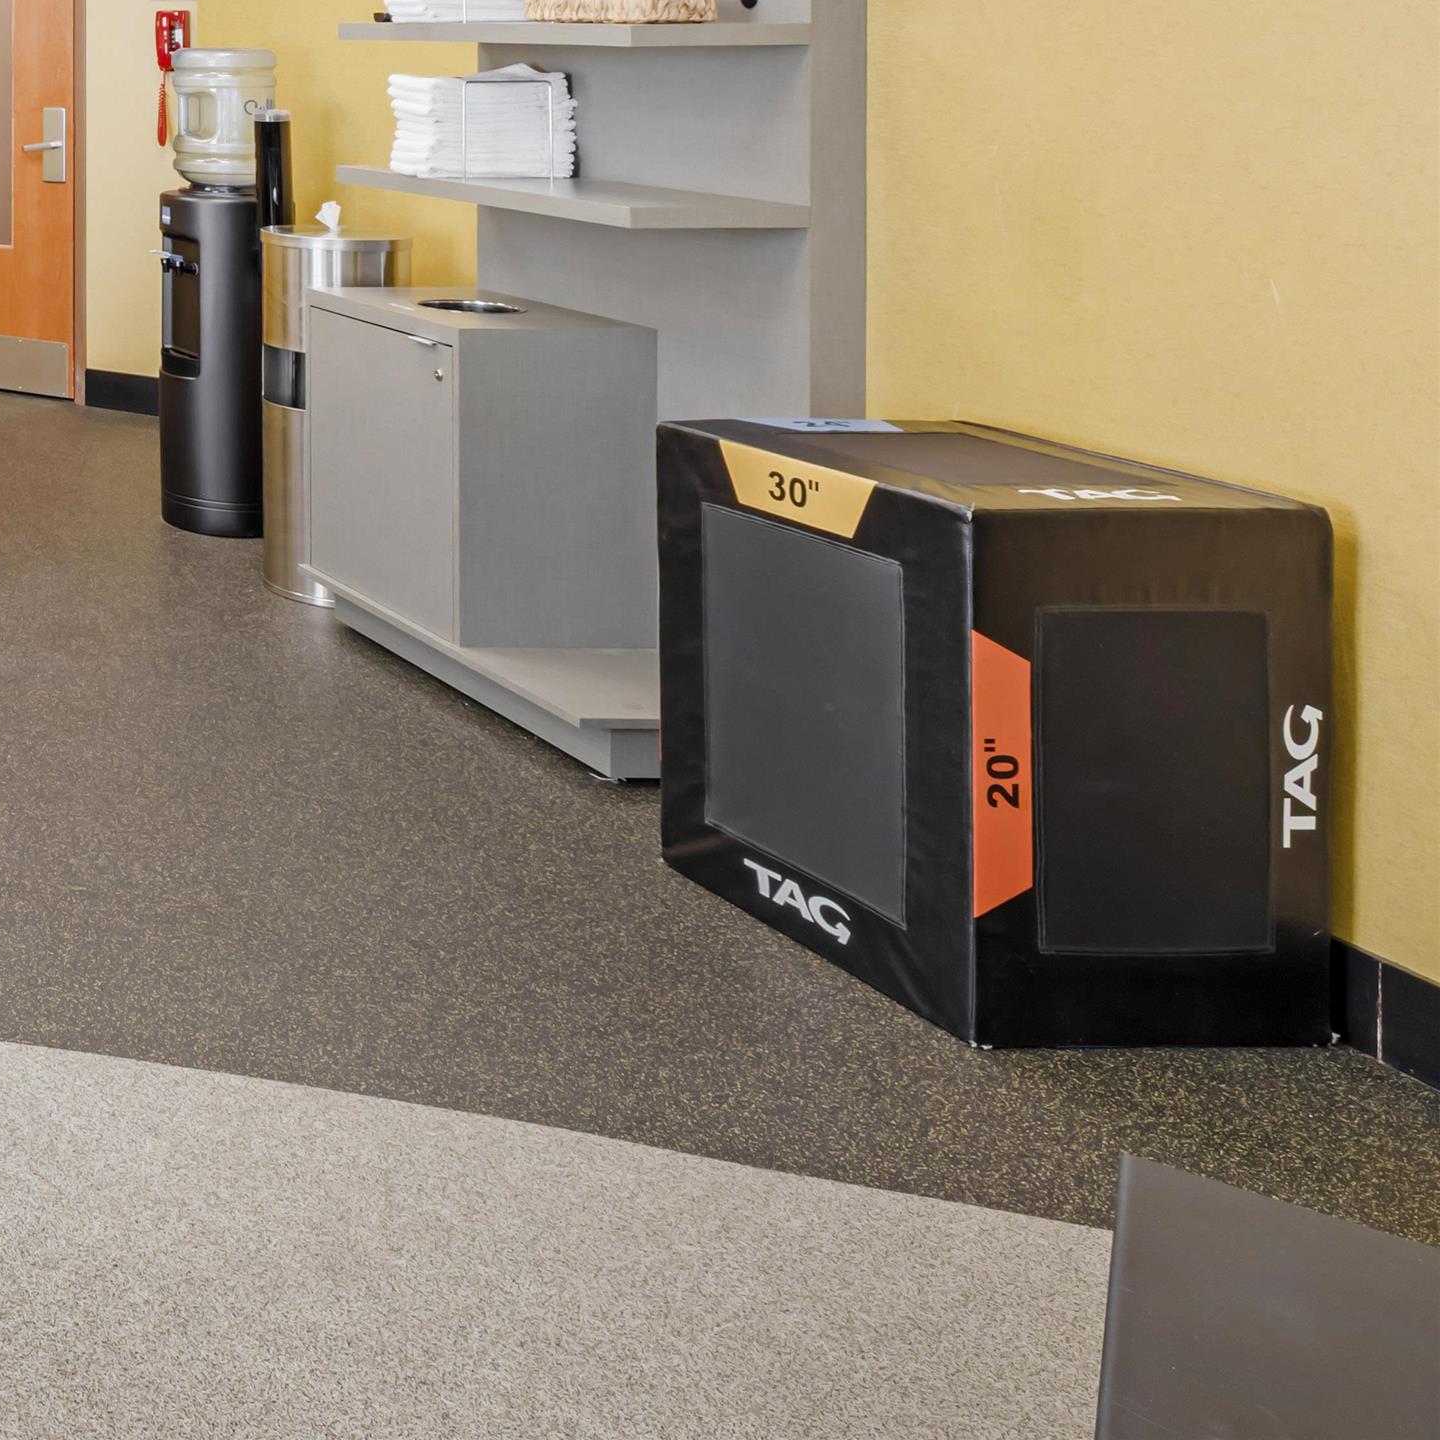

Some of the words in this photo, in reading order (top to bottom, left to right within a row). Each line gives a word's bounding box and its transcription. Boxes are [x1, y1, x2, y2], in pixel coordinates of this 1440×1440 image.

[768, 470, 819, 508] 30"
[1018, 488, 1182, 502] TAG
[984, 738, 1020, 810] 20"
[1283, 704, 1324, 848] TAG
[743, 858, 852, 946] TAG
